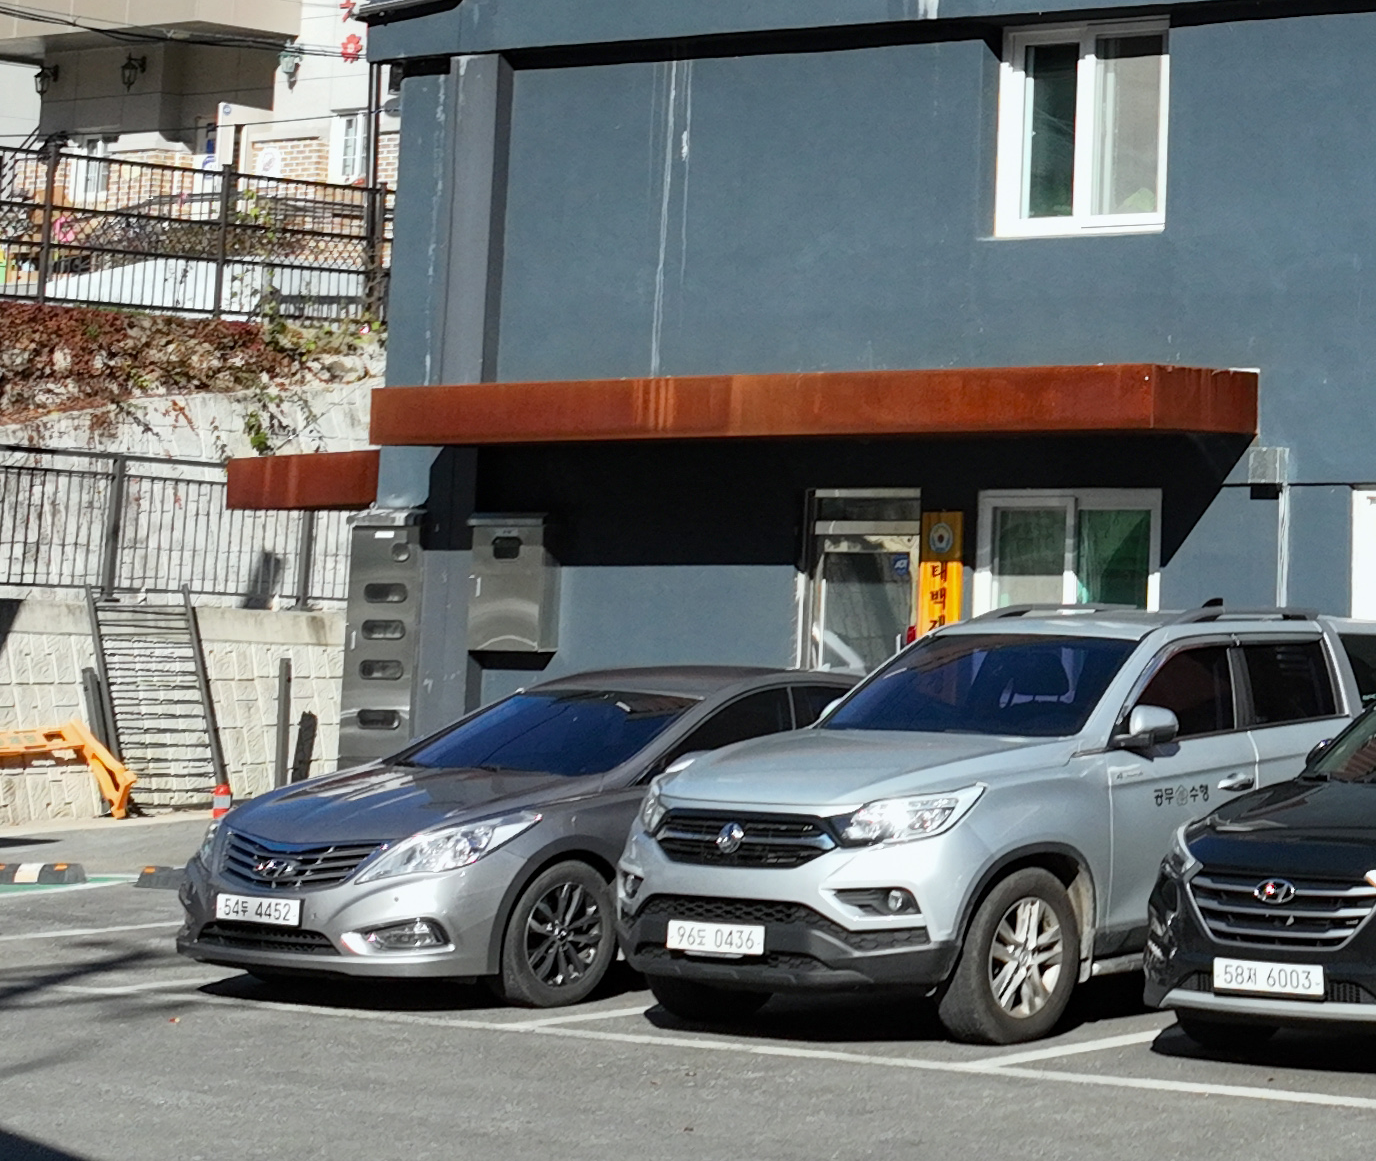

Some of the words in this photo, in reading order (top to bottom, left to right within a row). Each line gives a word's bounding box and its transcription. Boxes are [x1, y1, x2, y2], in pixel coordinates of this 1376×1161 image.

[255, 901, 291, 921] 4452
[714, 929, 754, 949] 0436
[1266, 967, 1312, 990] 6003
